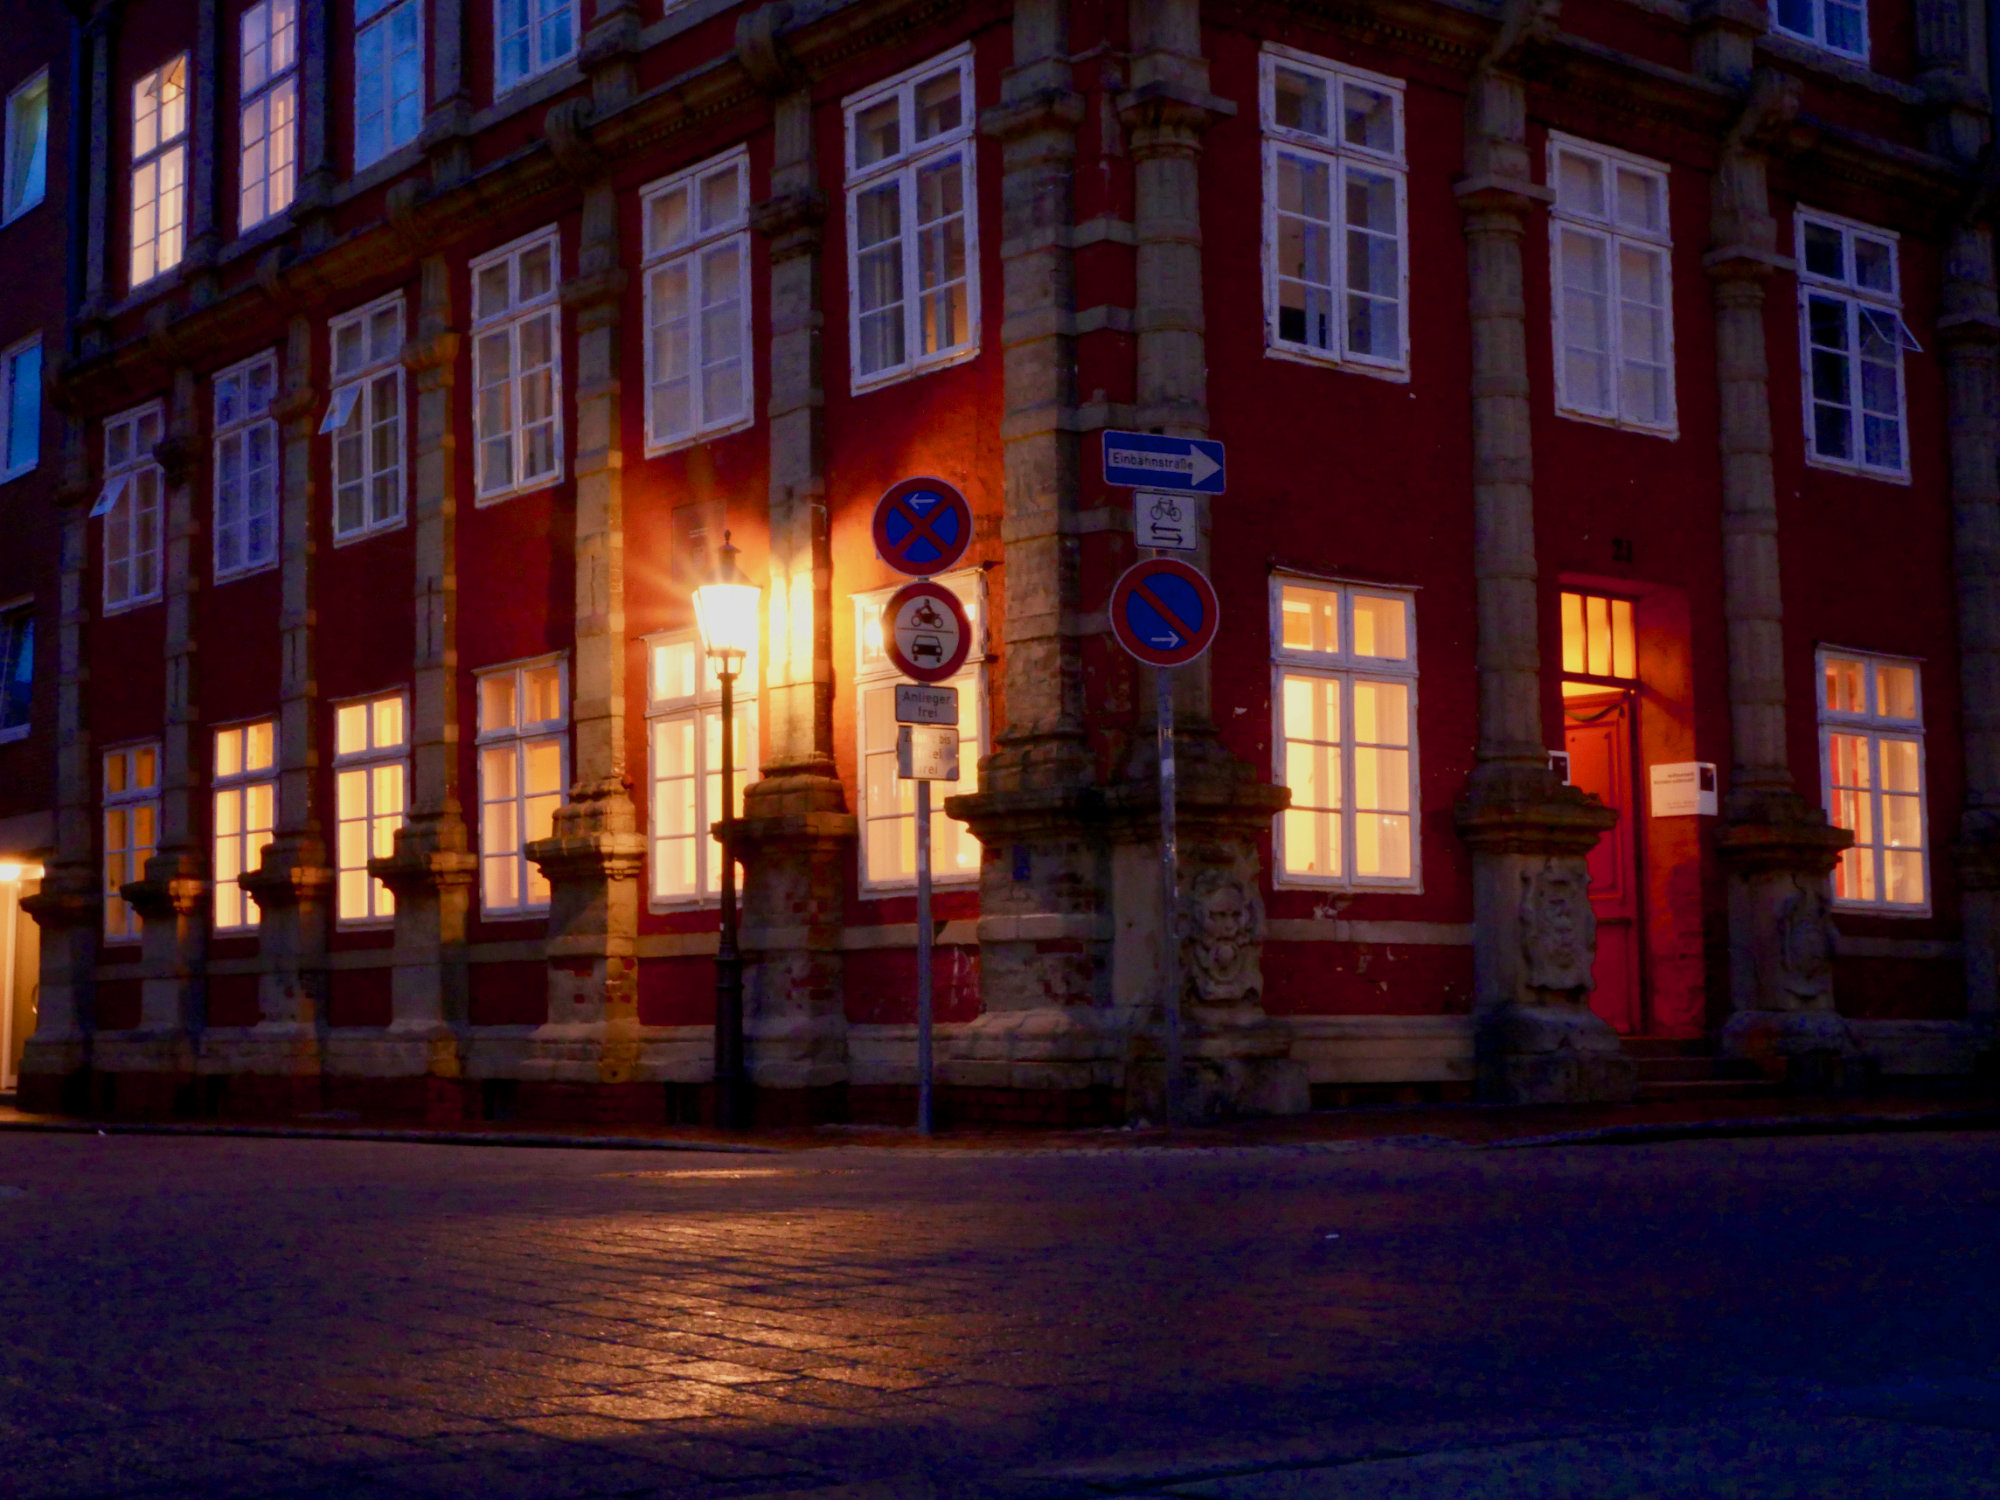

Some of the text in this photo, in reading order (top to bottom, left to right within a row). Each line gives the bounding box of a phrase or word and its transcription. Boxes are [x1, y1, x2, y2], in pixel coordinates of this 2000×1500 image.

[1113, 452, 1193, 470] Einbahnstraße
[902, 690, 951, 707] Anlieger
[917, 705, 938, 719] frei
